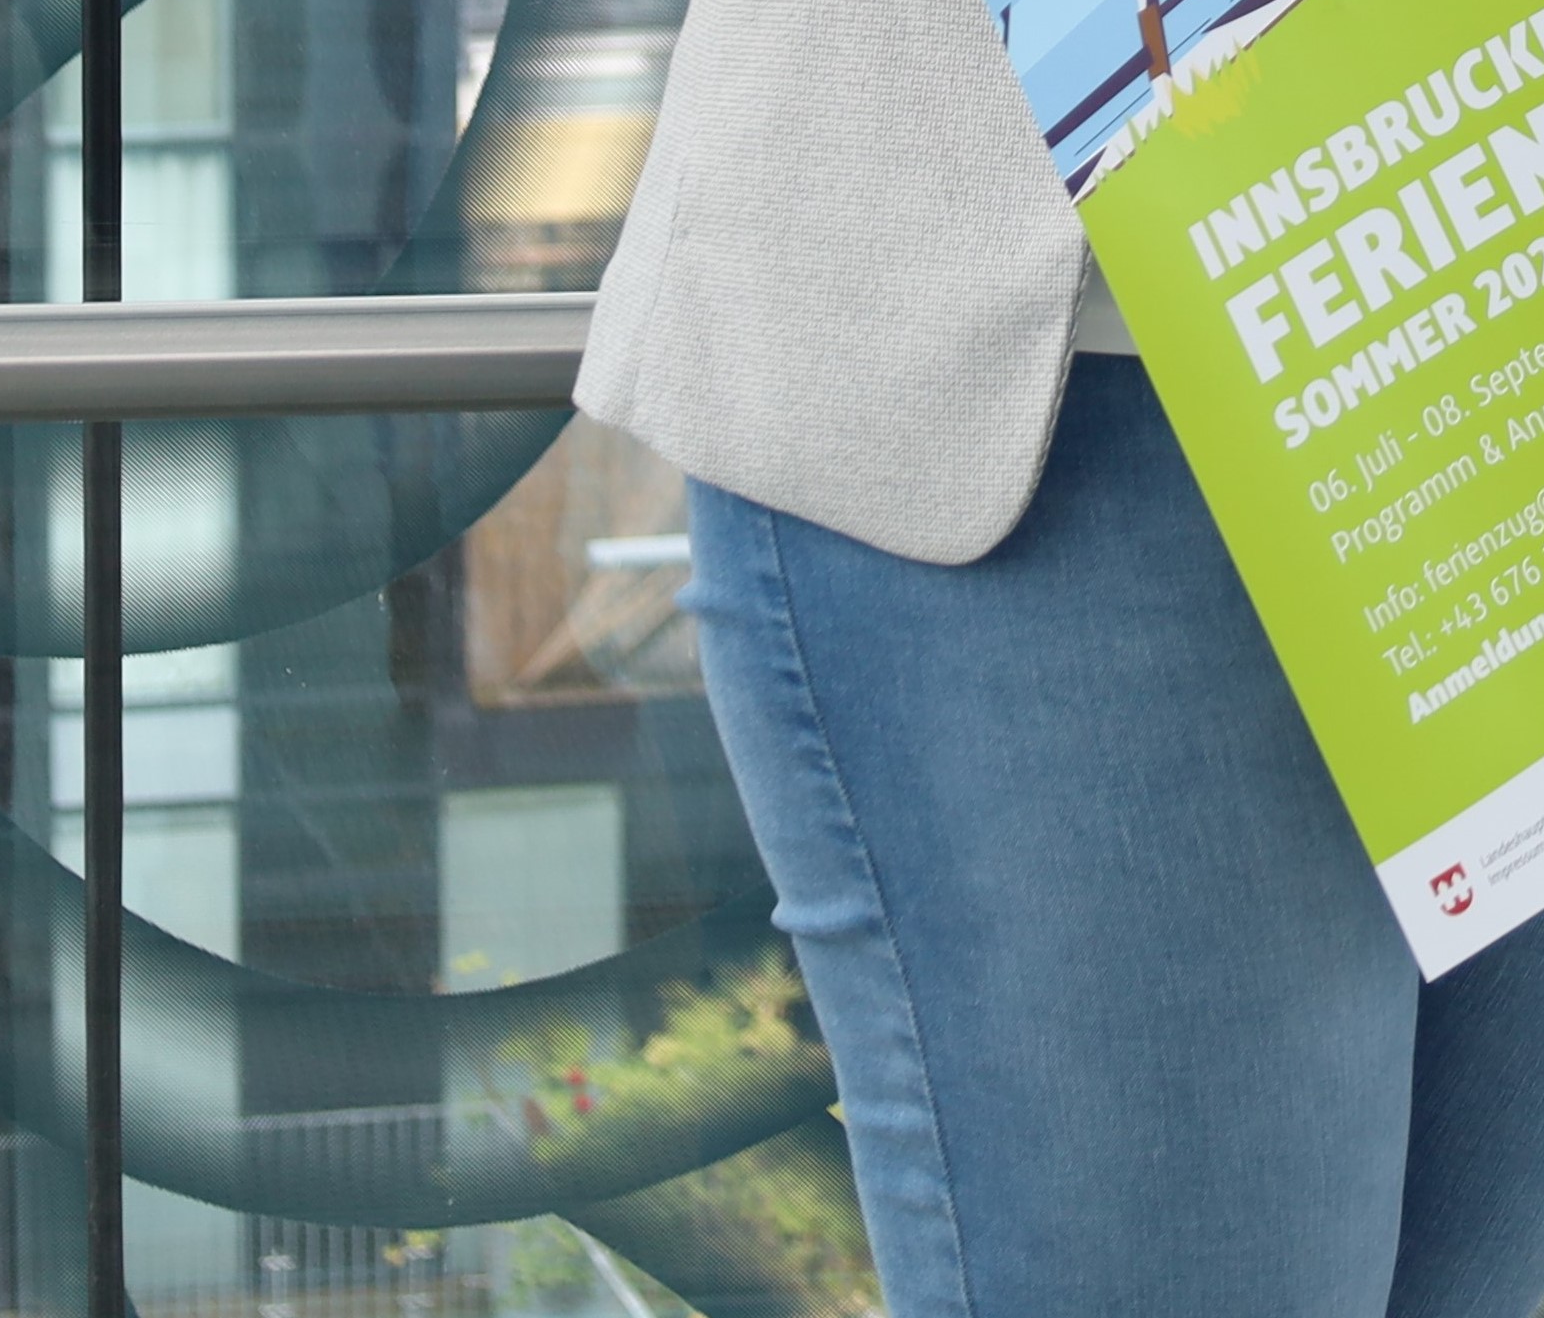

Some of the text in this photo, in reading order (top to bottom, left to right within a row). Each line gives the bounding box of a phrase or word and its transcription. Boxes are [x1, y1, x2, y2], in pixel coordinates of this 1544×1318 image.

[1275, 294, 1476, 448] SOMMER
[1309, 469, 1357, 513] 06.
[1355, 430, 1403, 492] Juli
[1422, 394, 1470, 437] 08.
[1331, 455, 1477, 564] Programm
[1479, 434, 1505, 465] &
[1364, 582, 1425, 632] Info:
[1382, 632, 1437, 675] Tel.:
[1441, 593, 1488, 635] +43
[1490, 556, 1541, 606] 676
